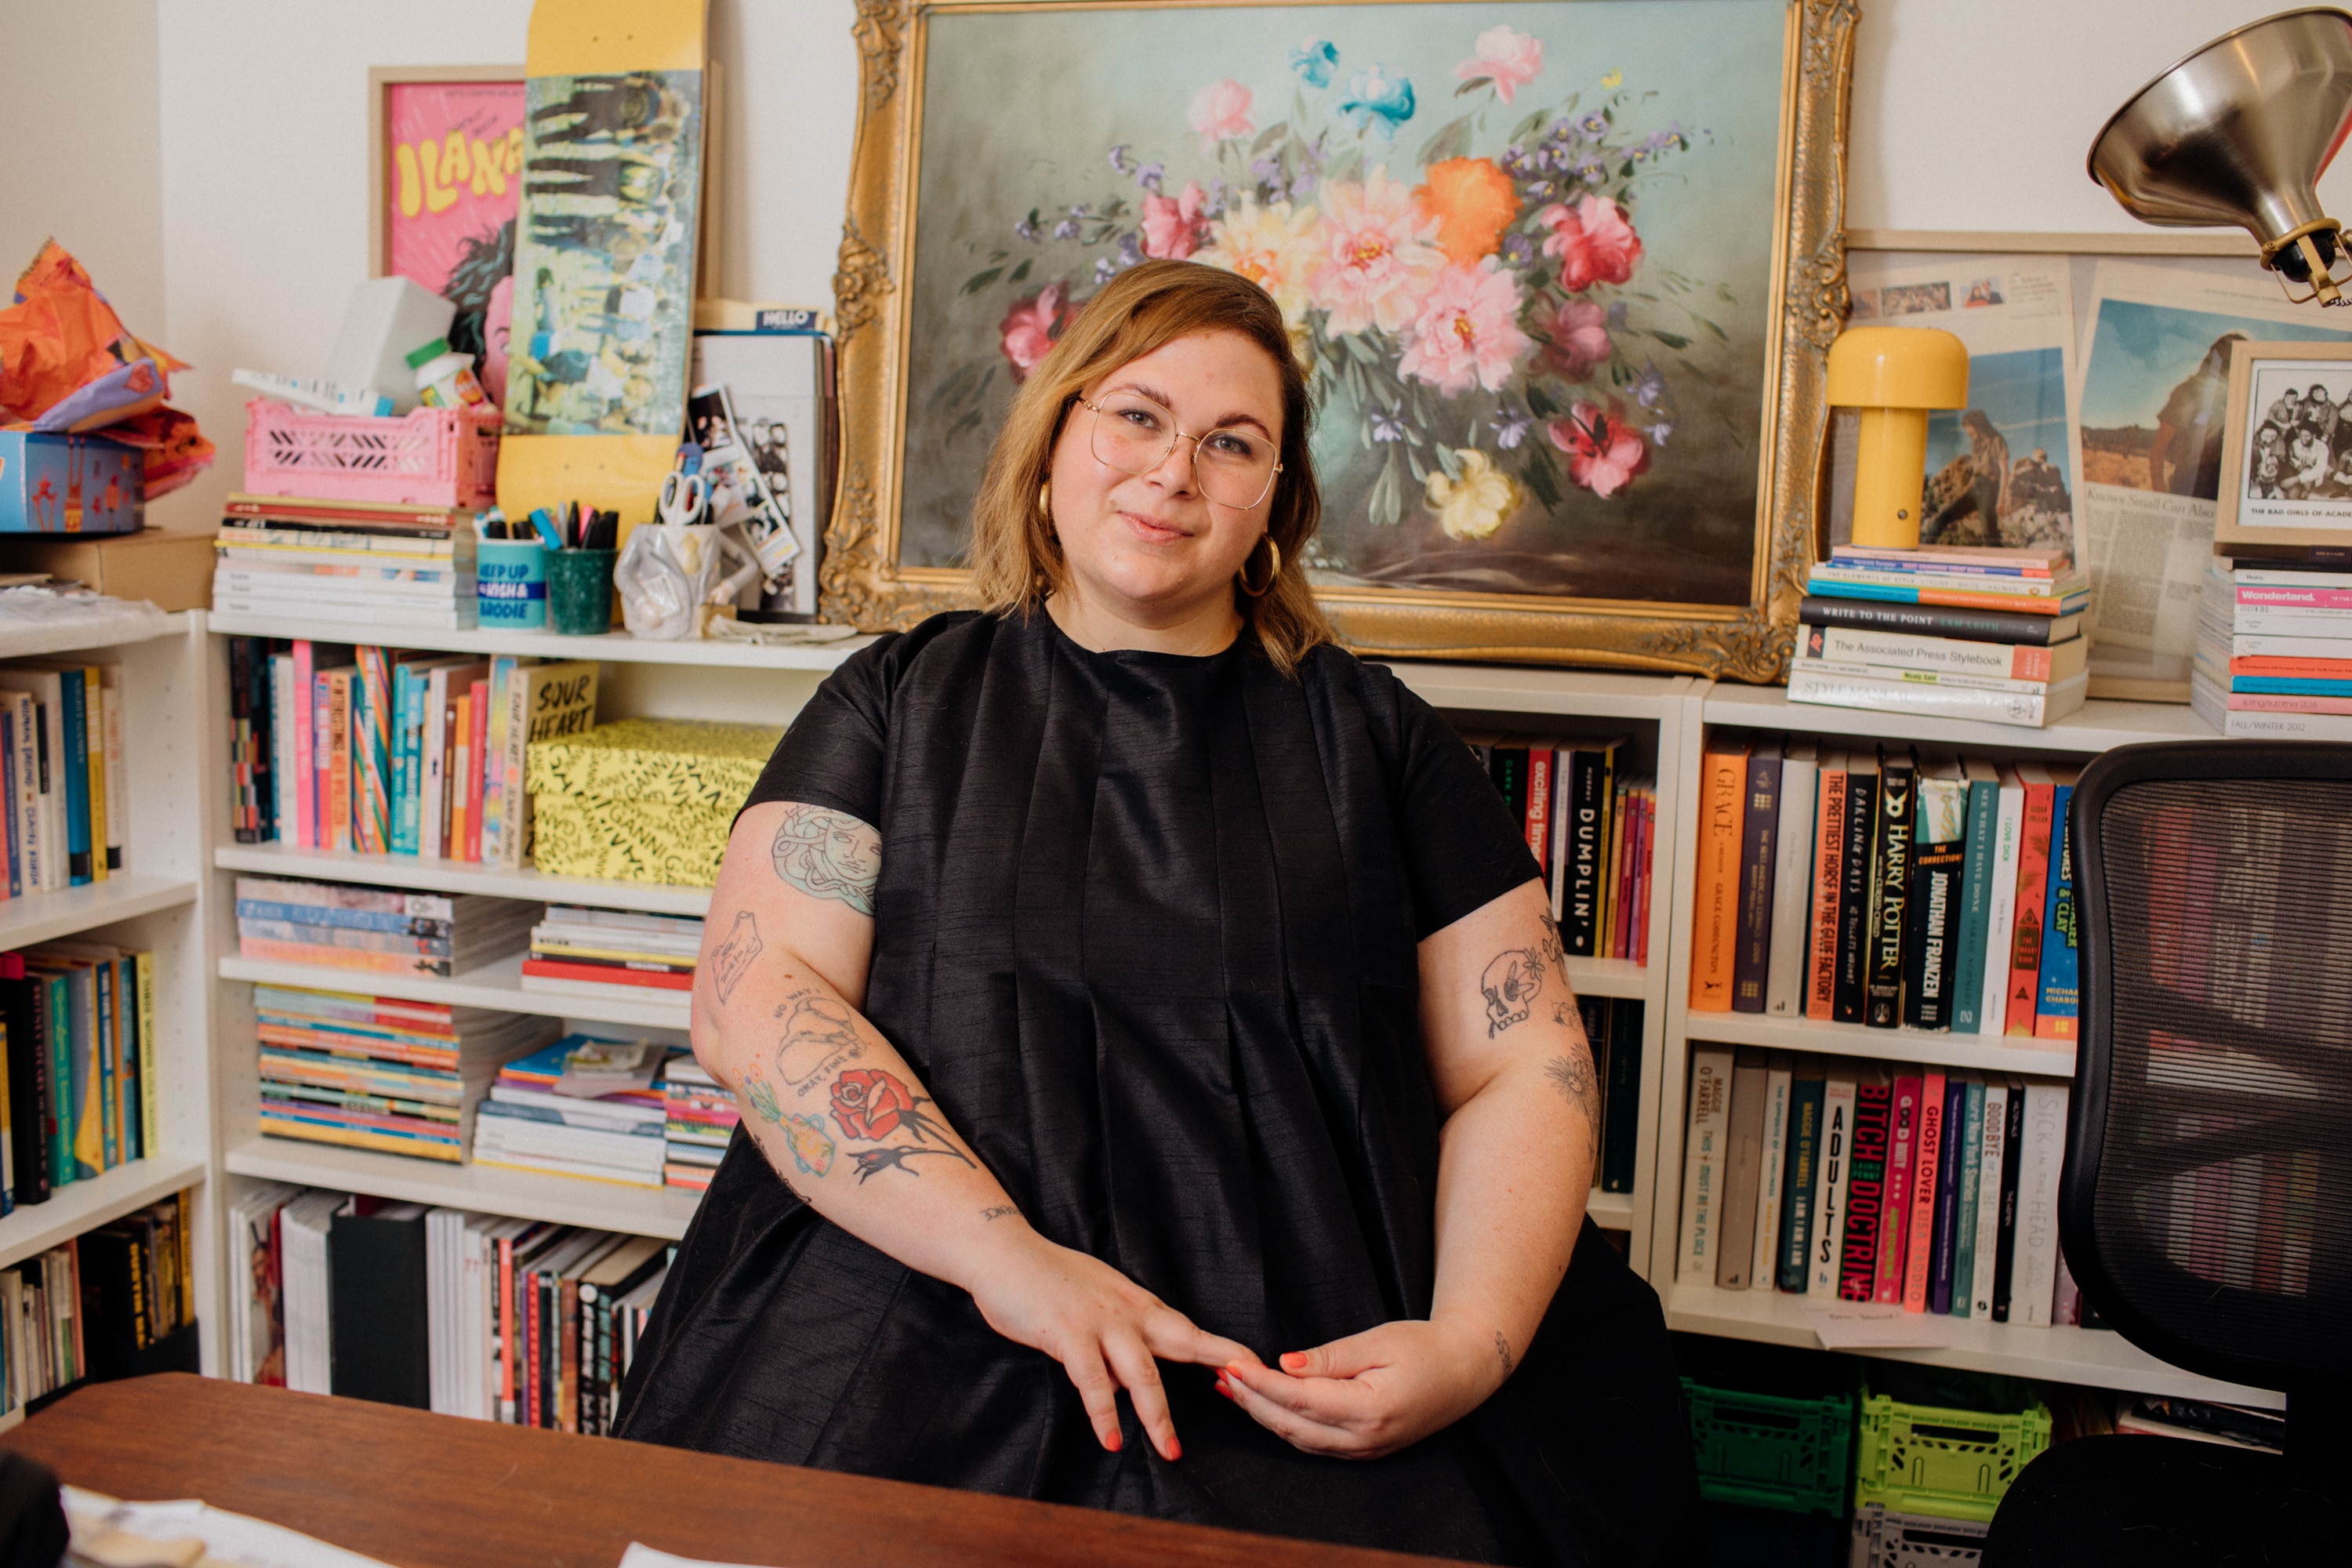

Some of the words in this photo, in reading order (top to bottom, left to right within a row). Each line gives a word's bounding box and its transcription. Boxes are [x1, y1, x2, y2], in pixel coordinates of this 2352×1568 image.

[763, 310, 809, 326] HELLO
[2087, 488, 2127, 505] Knows
[2129, 493, 2160, 509] Small
[2162, 499, 2186, 514] Can
[2191, 503, 2215, 517] Also
[2241, 590, 2315, 602] Wonderland.
[1823, 607, 1856, 619] WRITE
[1860, 610, 1873, 620] TO
[1876, 612, 1896, 622] THE
[1900, 614, 1933, 626] POINT
[1940, 618, 1964, 628] SAM
[1966, 620, 2000, 632] LEITH
[1835, 639, 1854, 652] The
[1857, 641, 1914, 658] Associated
[1917, 648, 1946, 661] Press
[1950, 650, 2002, 666] Stylebook
[1805, 681, 1846, 694] STYLE
[1904, 672, 1922, 681] Nicely
[1923, 673, 1936, 681] Said
[537, 673, 590, 712] SOUR
[528, 706, 592, 743] HEART
[2231, 721, 2284, 731] FALL/WINTER
[2287, 723, 2306, 731] 2012
[625, 753, 671, 800] GANNI
[1504, 759, 1513, 790] DARK
[1530, 760, 1546, 819] exciting
[1829, 775, 1843, 794] THE
[1712, 768, 1736, 837] GRACE
[1980, 788, 1989, 808] SEE
[609, 803, 668, 862] GANNI
[1824, 797, 1842, 851] PRETTIEST
[1851, 787, 1868, 854] DARLING
[1977, 811, 1987, 842] WHAT
[2003, 822, 2012, 842] LOVE
[1886, 824, 1909, 891] HARRY
[1934, 844, 1947, 855] THE
[2002, 844, 2011, 862] DICK
[1574, 808, 1595, 927] DUMPLIN'
[1824, 854, 1838, 889] HORSE
[1850, 858, 1863, 895] DAYS
[1973, 853, 1984, 880] HAVE
[1713, 883, 1723, 913] GRACE
[1823, 891, 1837, 903] IN
[1874, 877, 1884, 908] CURSED
[1927, 871, 1949, 937] JONATHAN
[1971, 883, 1982, 913] DONE
[2057, 888, 2068, 898] &
[1820, 906, 1836, 925] THE
[1871, 910, 1882, 938] CHILD
[2056, 902, 2068, 934] CLAY
[1710, 914, 1722, 975] CODDINGTON
[1820, 927, 1835, 956] GLUE
[1880, 896, 1904, 971] POTTER
[1922, 938, 1944, 998] FRANZEN
[2019, 955, 2033, 964] BOOK
[1816, 956, 1833, 1003] FACTORY
[33, 985, 42, 1040] BRITNEY
[775, 1004, 787, 1018] NO
[2045, 996, 2078, 1004] CHABO
[34, 1044, 44, 1092] SPEARS
[824, 1054, 848, 1074] FINE
[1695, 1065, 1711, 1125] O'FARRELL
[1710, 1077, 1724, 1114] MAGGIE
[1776, 1085, 1784, 1098] THE
[1969, 1088, 1981, 1119] more
[1773, 1102, 1784, 1138] OPPOSITE
[1799, 1102, 1814, 1138] MAGGIE
[1853, 1083, 1890, 1161] BITCH
[1897, 1095, 1913, 1140] GOOD
[1922, 1105, 1939, 1156] GHOST
[1967, 1120, 1981, 1143] New
[1984, 1102, 2002, 1158] GOODBYE
[2036, 1098, 2059, 1144] SICK
[1701, 1131, 1714, 1152] THIS
[1772, 1140, 1780, 1150] OF
[1965, 1145, 1979, 1167] York
[1795, 1141, 1812, 1189] O'FARRELL
[2038, 1150, 2047, 1165] IN
[1697, 1165, 1711, 1193] MUST
[1820, 1105, 1842, 1263] ADULTS
[1918, 1160, 1935, 1204] LOVER
[1963, 1167, 1976, 1203] Stories
[2036, 1173, 2048, 1196] THE
[1697, 1195, 1708, 1207] BE
[1695, 1209, 1708, 1225] THE
[1889, 1207, 1899, 1229] ANN
[1916, 1210, 1929, 1239] LISA
[2027, 1201, 2047, 1248] HEAD
[1693, 1227, 1707, 1257] PLACE
[1840, 1181, 1882, 1303] DOCTRINE
[1884, 1232, 1897, 1279] POWERS
[1909, 1246, 1926, 1302] TADDEO
